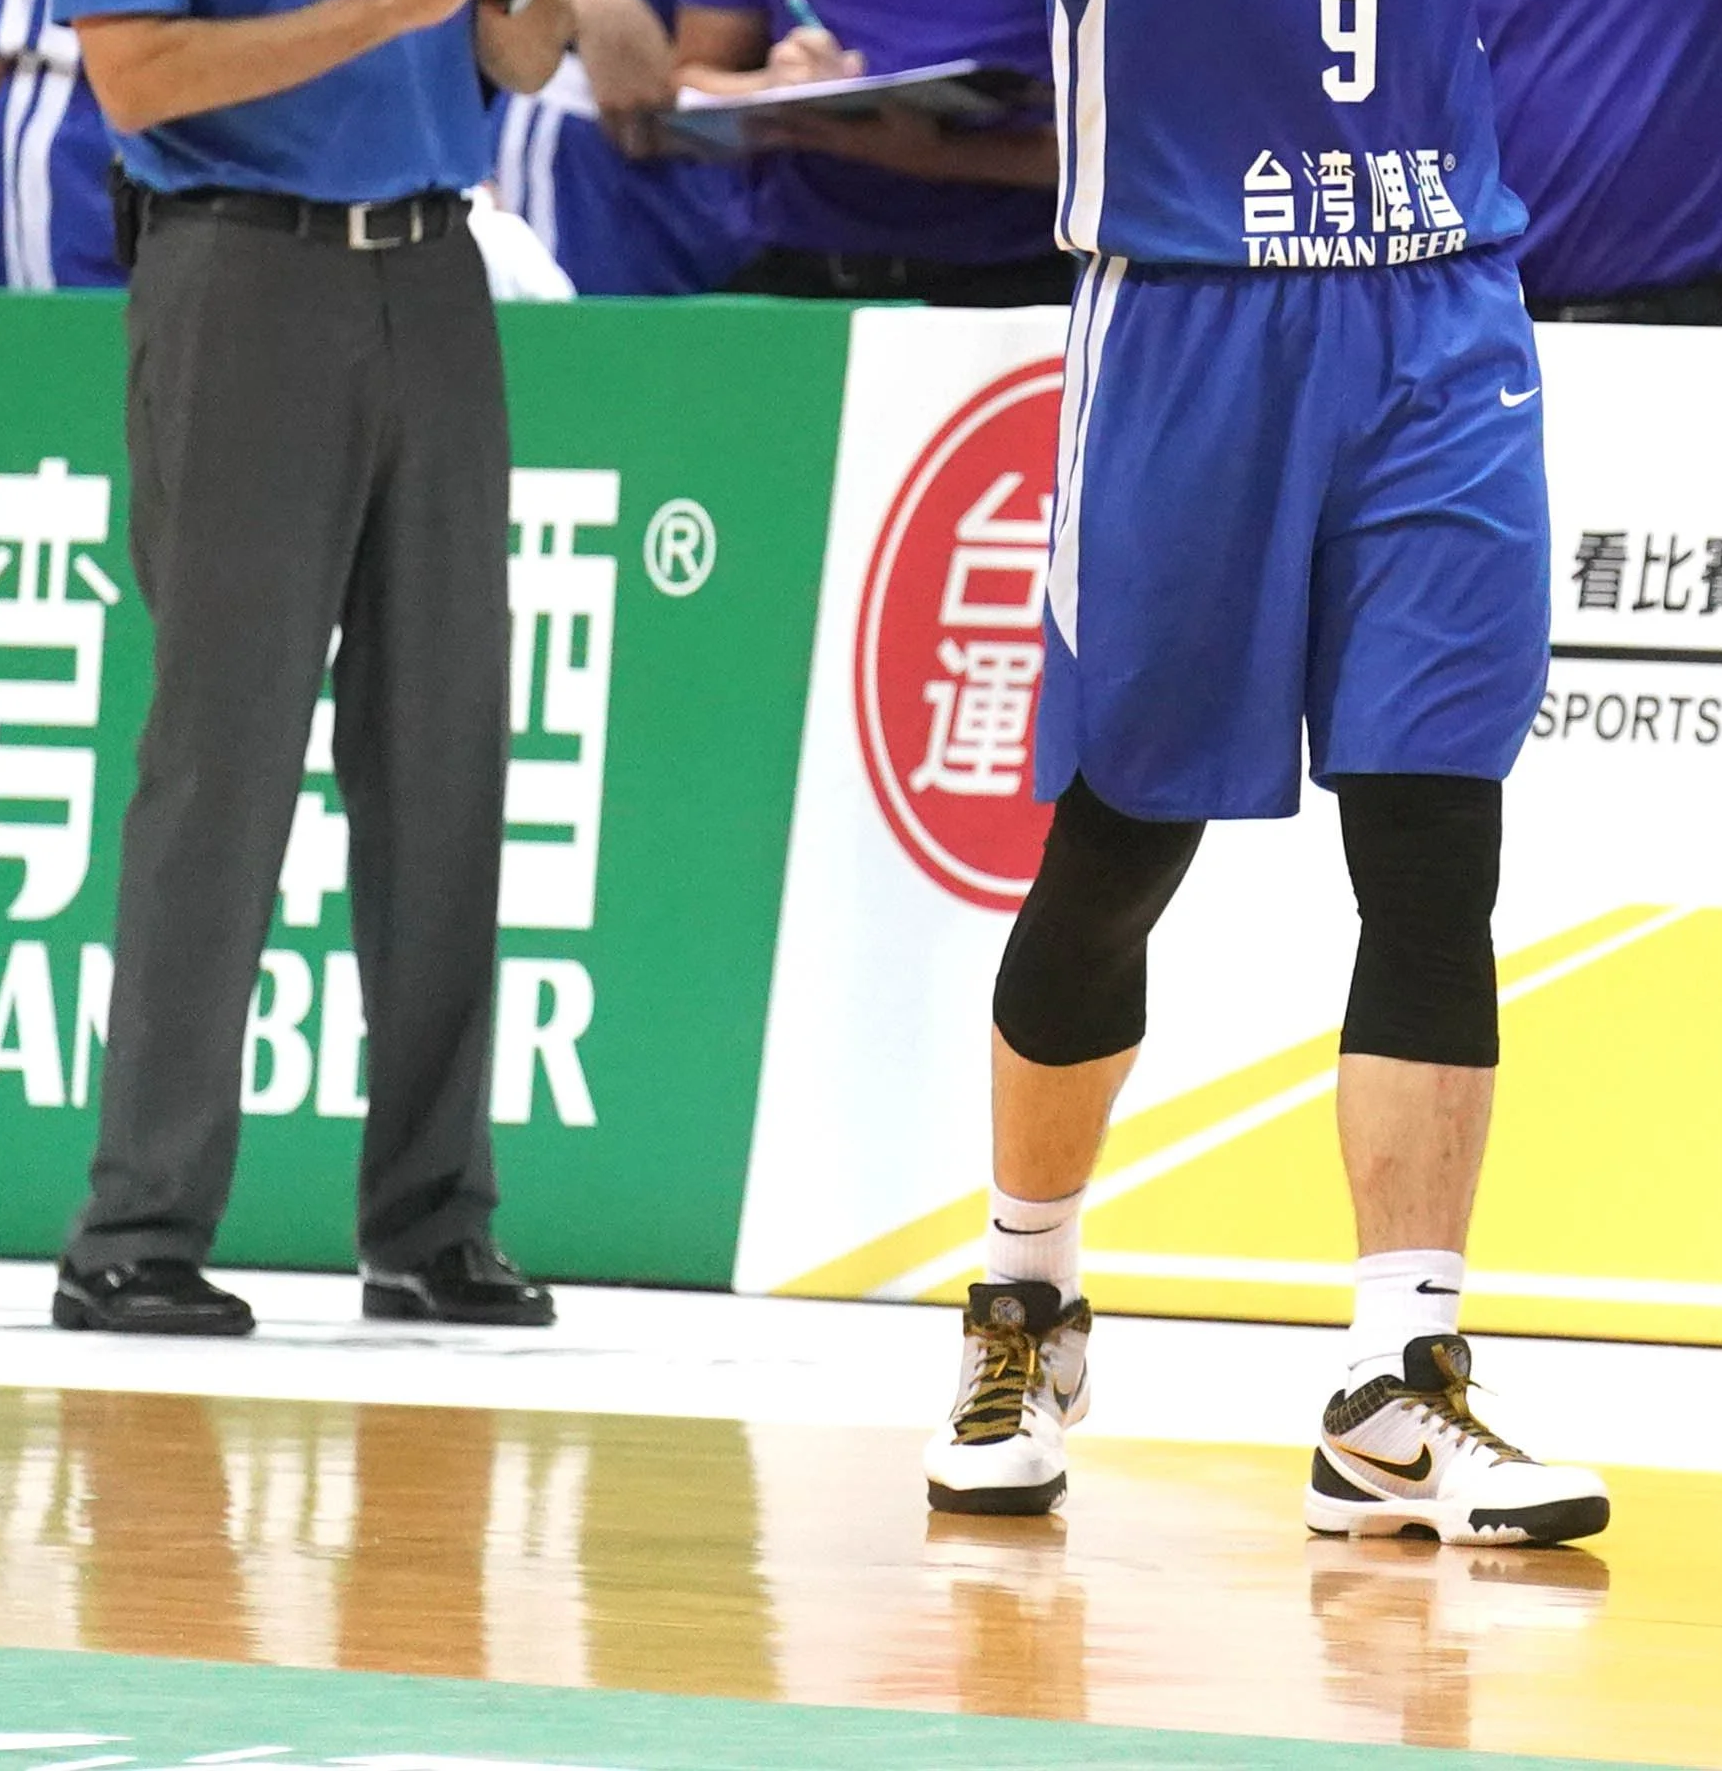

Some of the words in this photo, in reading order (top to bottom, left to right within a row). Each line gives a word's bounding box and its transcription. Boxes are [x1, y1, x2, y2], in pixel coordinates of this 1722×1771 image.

[1242, 236, 1376, 268] TAIWAN
[1386, 227, 1467, 266] BEER
[1530, 688, 1722, 745] SPORTS
